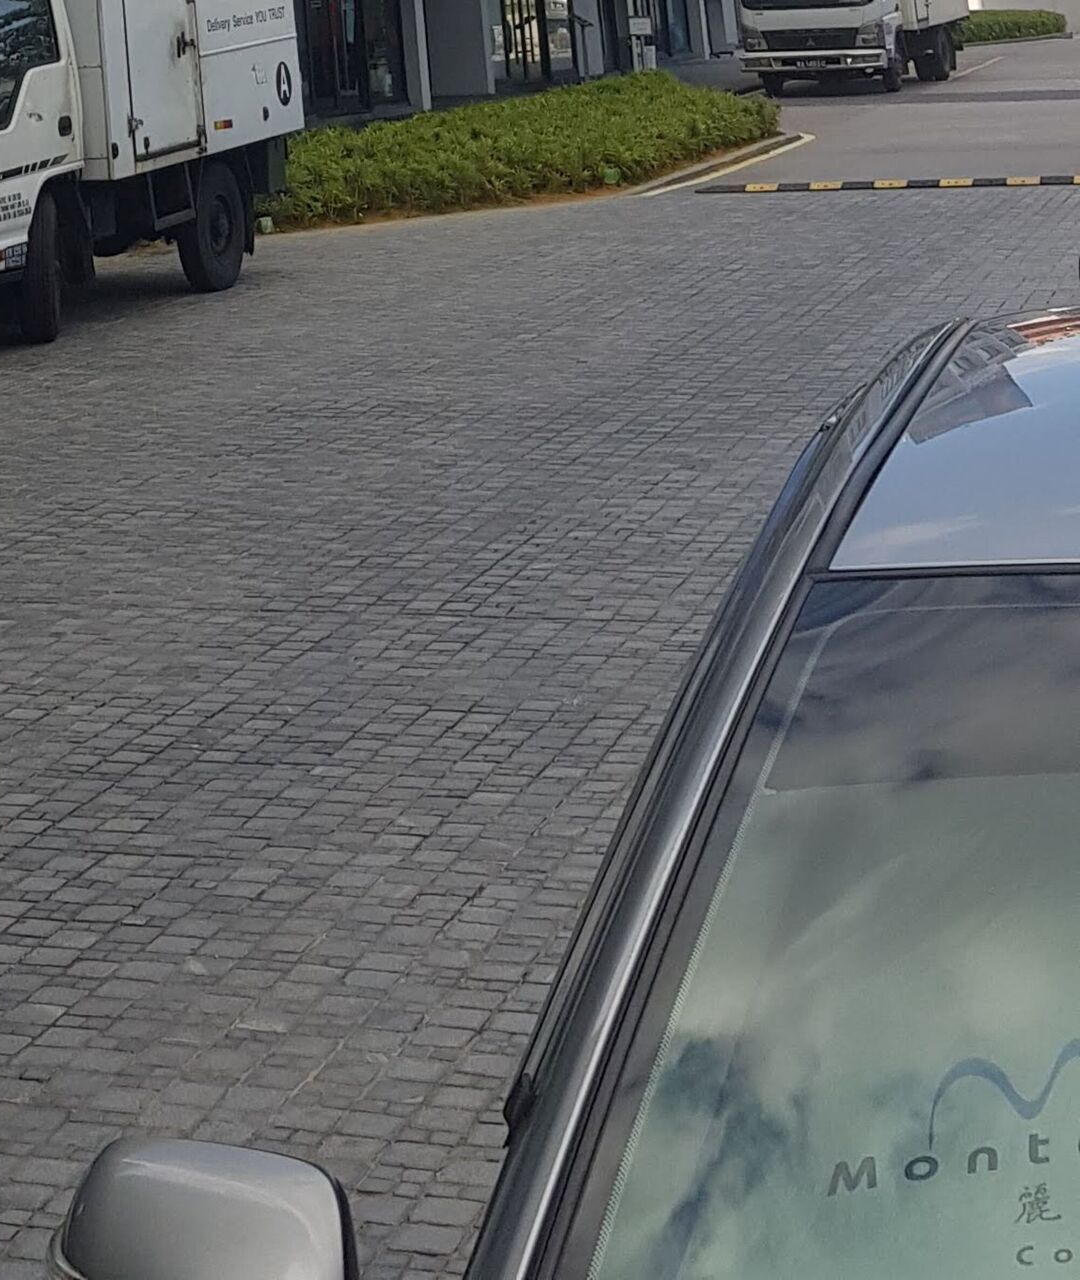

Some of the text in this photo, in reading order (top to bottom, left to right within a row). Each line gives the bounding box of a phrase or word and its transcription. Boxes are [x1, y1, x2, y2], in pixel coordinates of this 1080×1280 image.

[206, 5, 286, 33] Delivery Service YOU TRUST
[827, 1132, 1080, 1197] Mont
